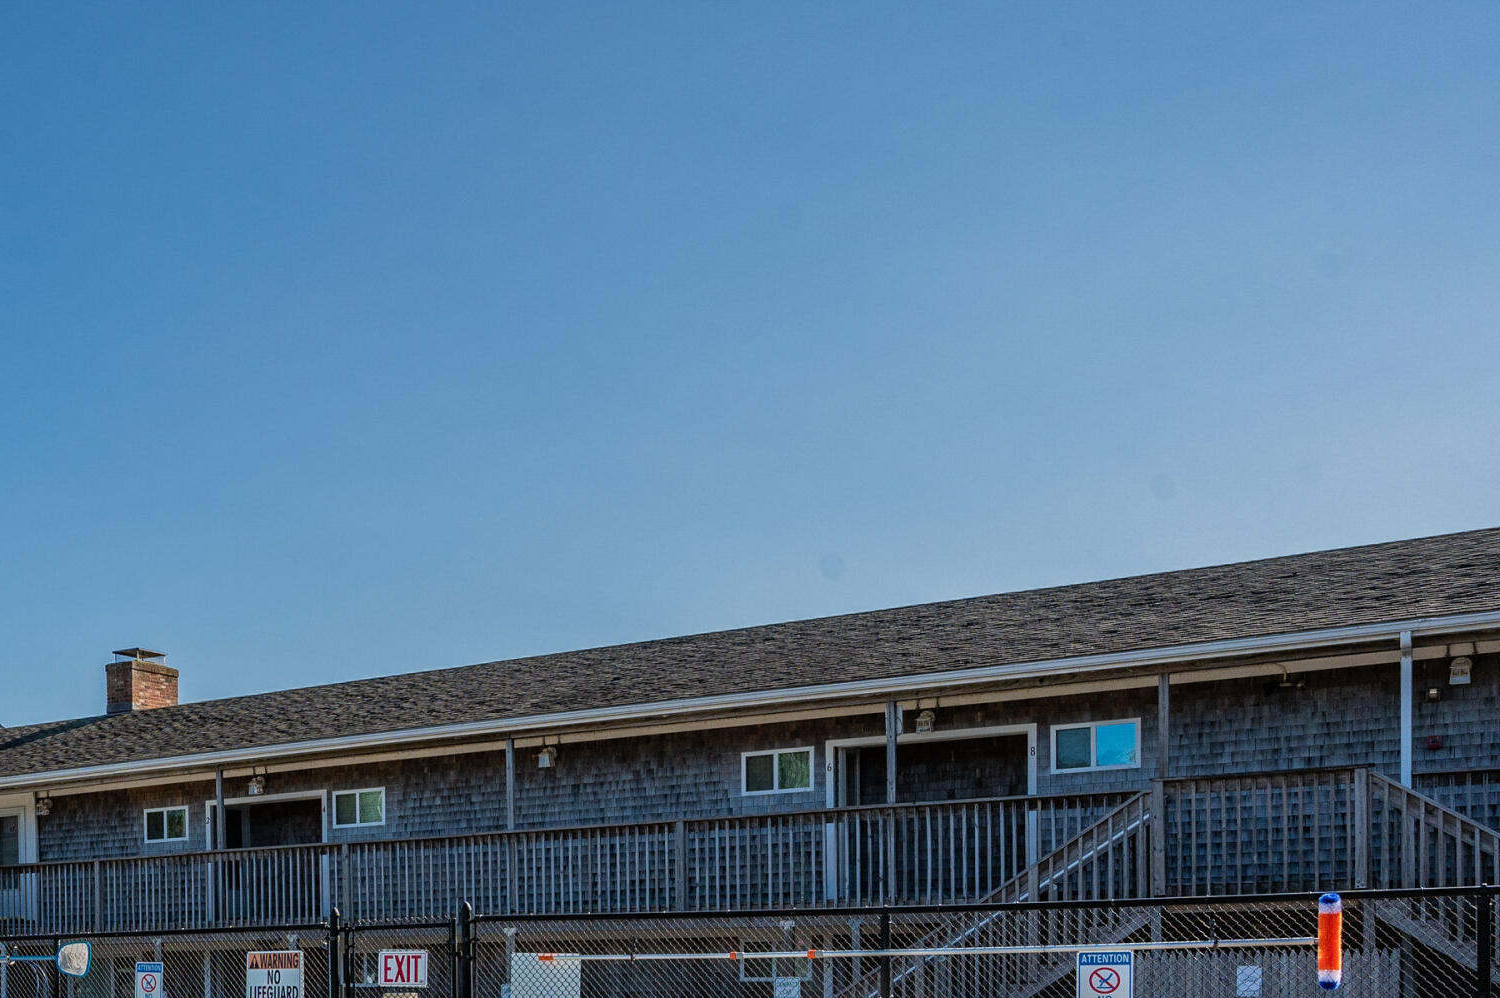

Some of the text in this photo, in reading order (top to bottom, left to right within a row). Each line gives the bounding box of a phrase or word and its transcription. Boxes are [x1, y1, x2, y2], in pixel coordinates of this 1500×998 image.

[1030, 746, 1036, 756] 8
[260, 953, 299, 969] WARNING
[1081, 953, 1129, 963] ATTENTION
[383, 955, 422, 983] EXIT
[267, 970, 281, 985] NO
